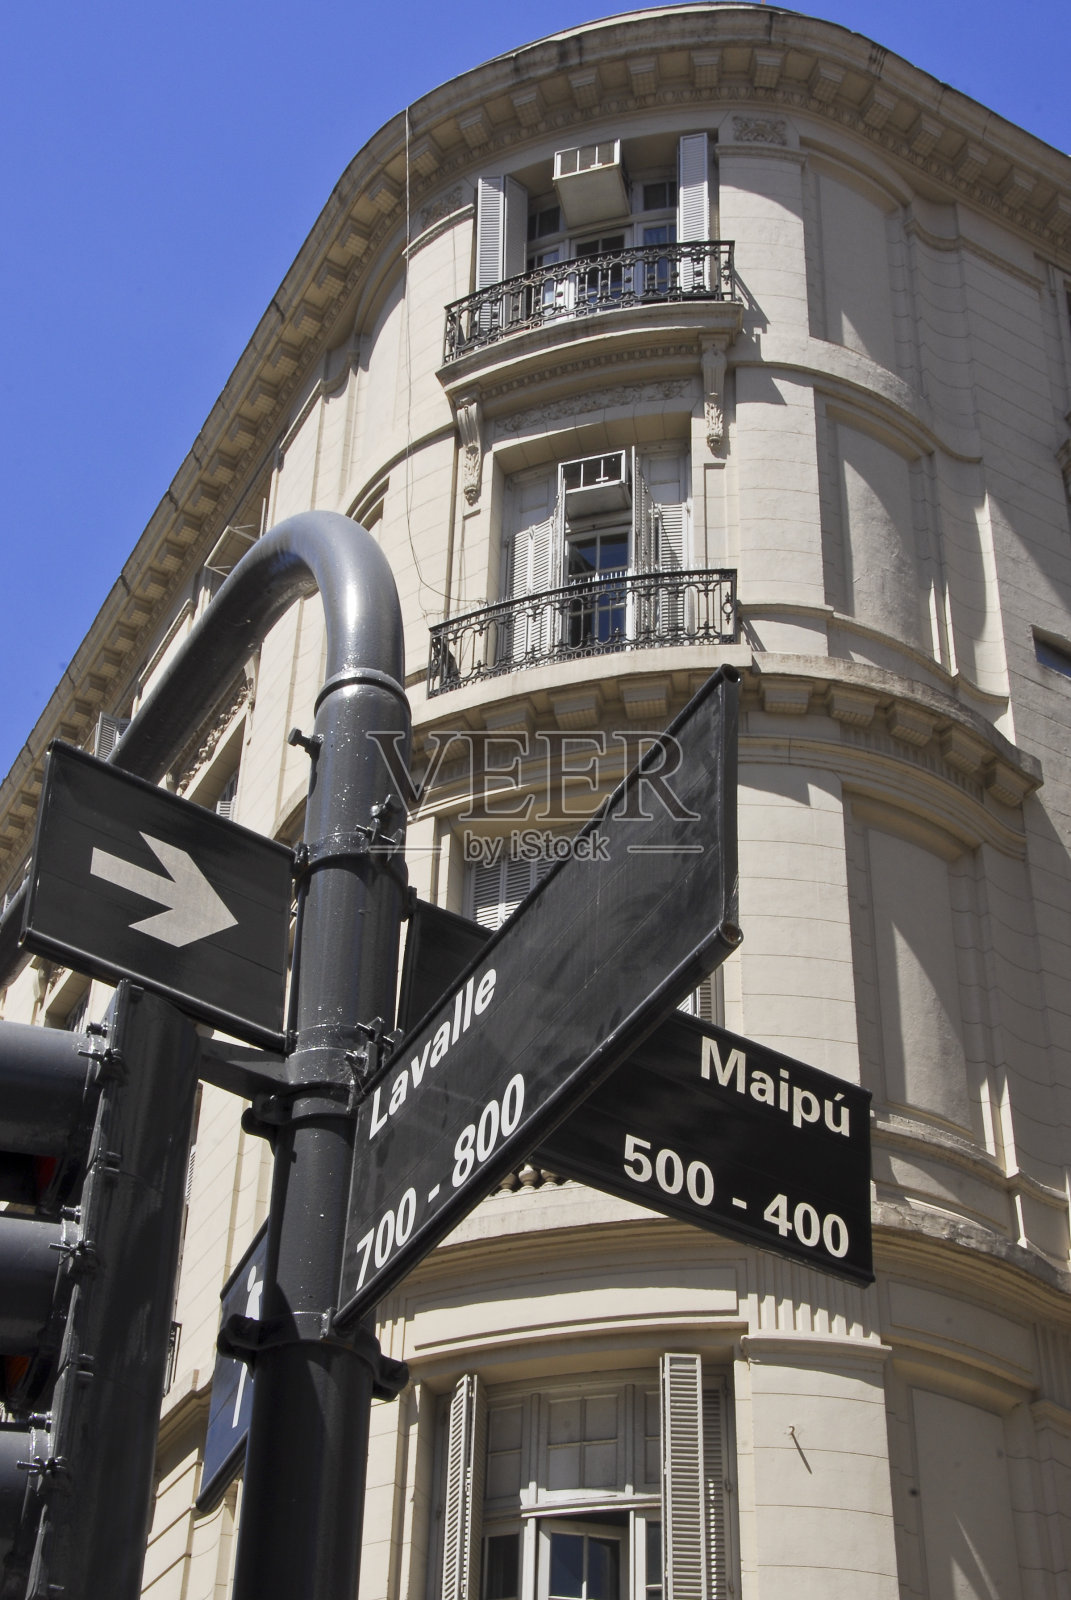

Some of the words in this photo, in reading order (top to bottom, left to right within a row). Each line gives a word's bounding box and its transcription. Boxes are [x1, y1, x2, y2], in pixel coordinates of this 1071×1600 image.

[369, 968, 497, 1140] Lavalle
[701, 1036, 851, 1138] Maipú
[355, 1187, 416, 1291] 700
[452, 1073, 525, 1189] 800
[623, 1133, 715, 1206] 500
[763, 1193, 849, 1259] 400
